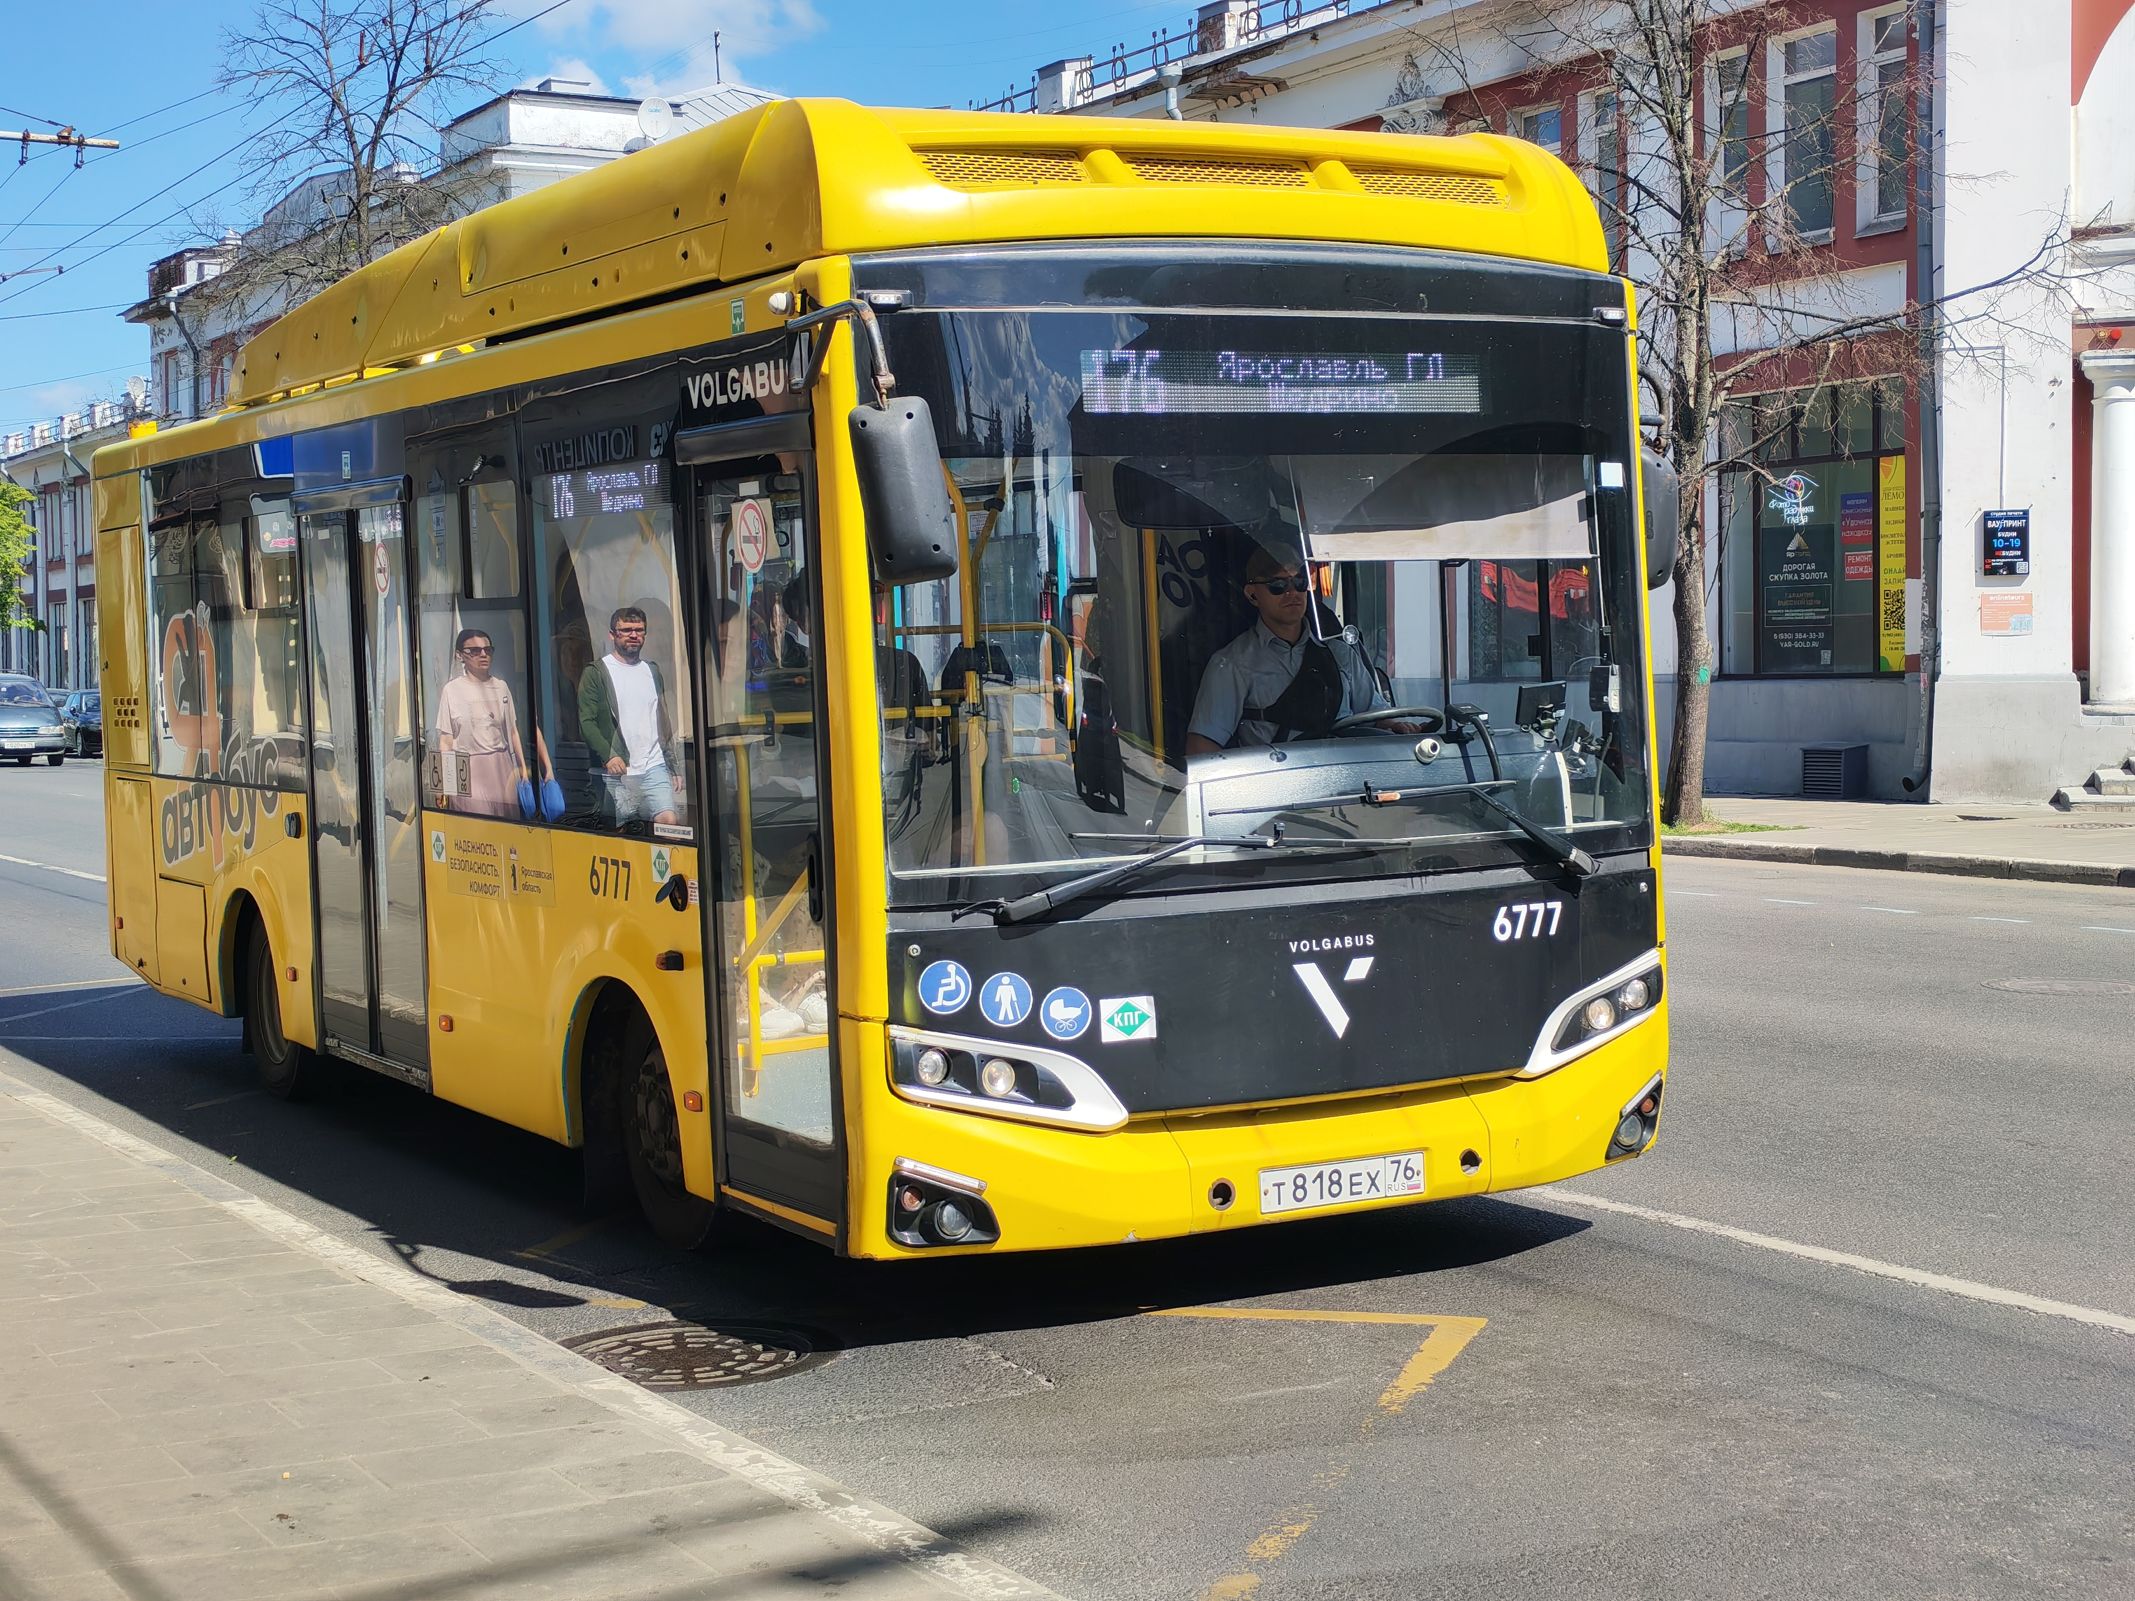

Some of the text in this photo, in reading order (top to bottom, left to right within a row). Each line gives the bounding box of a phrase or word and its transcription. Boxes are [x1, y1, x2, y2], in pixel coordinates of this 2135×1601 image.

[1218, 351, 1388, 382] Ярославль
[687, 358, 789, 409] VOLGABU
[1769, 572, 1828, 581] СКУПКА ЗОЛОТА
[1783, 563, 1816, 572] ДОРОГАЯ
[590, 855, 631, 901] 6777
[470, 881, 500, 897] КОМФОРТ
[1494, 901, 1562, 942] 6777
[1289, 934, 1375, 954] VOLGABUS
[1114, 1010, 1143, 1028] КПГ
[1390, 1158, 1415, 1183] 76
[1387, 1182, 1407, 1193] RUS
